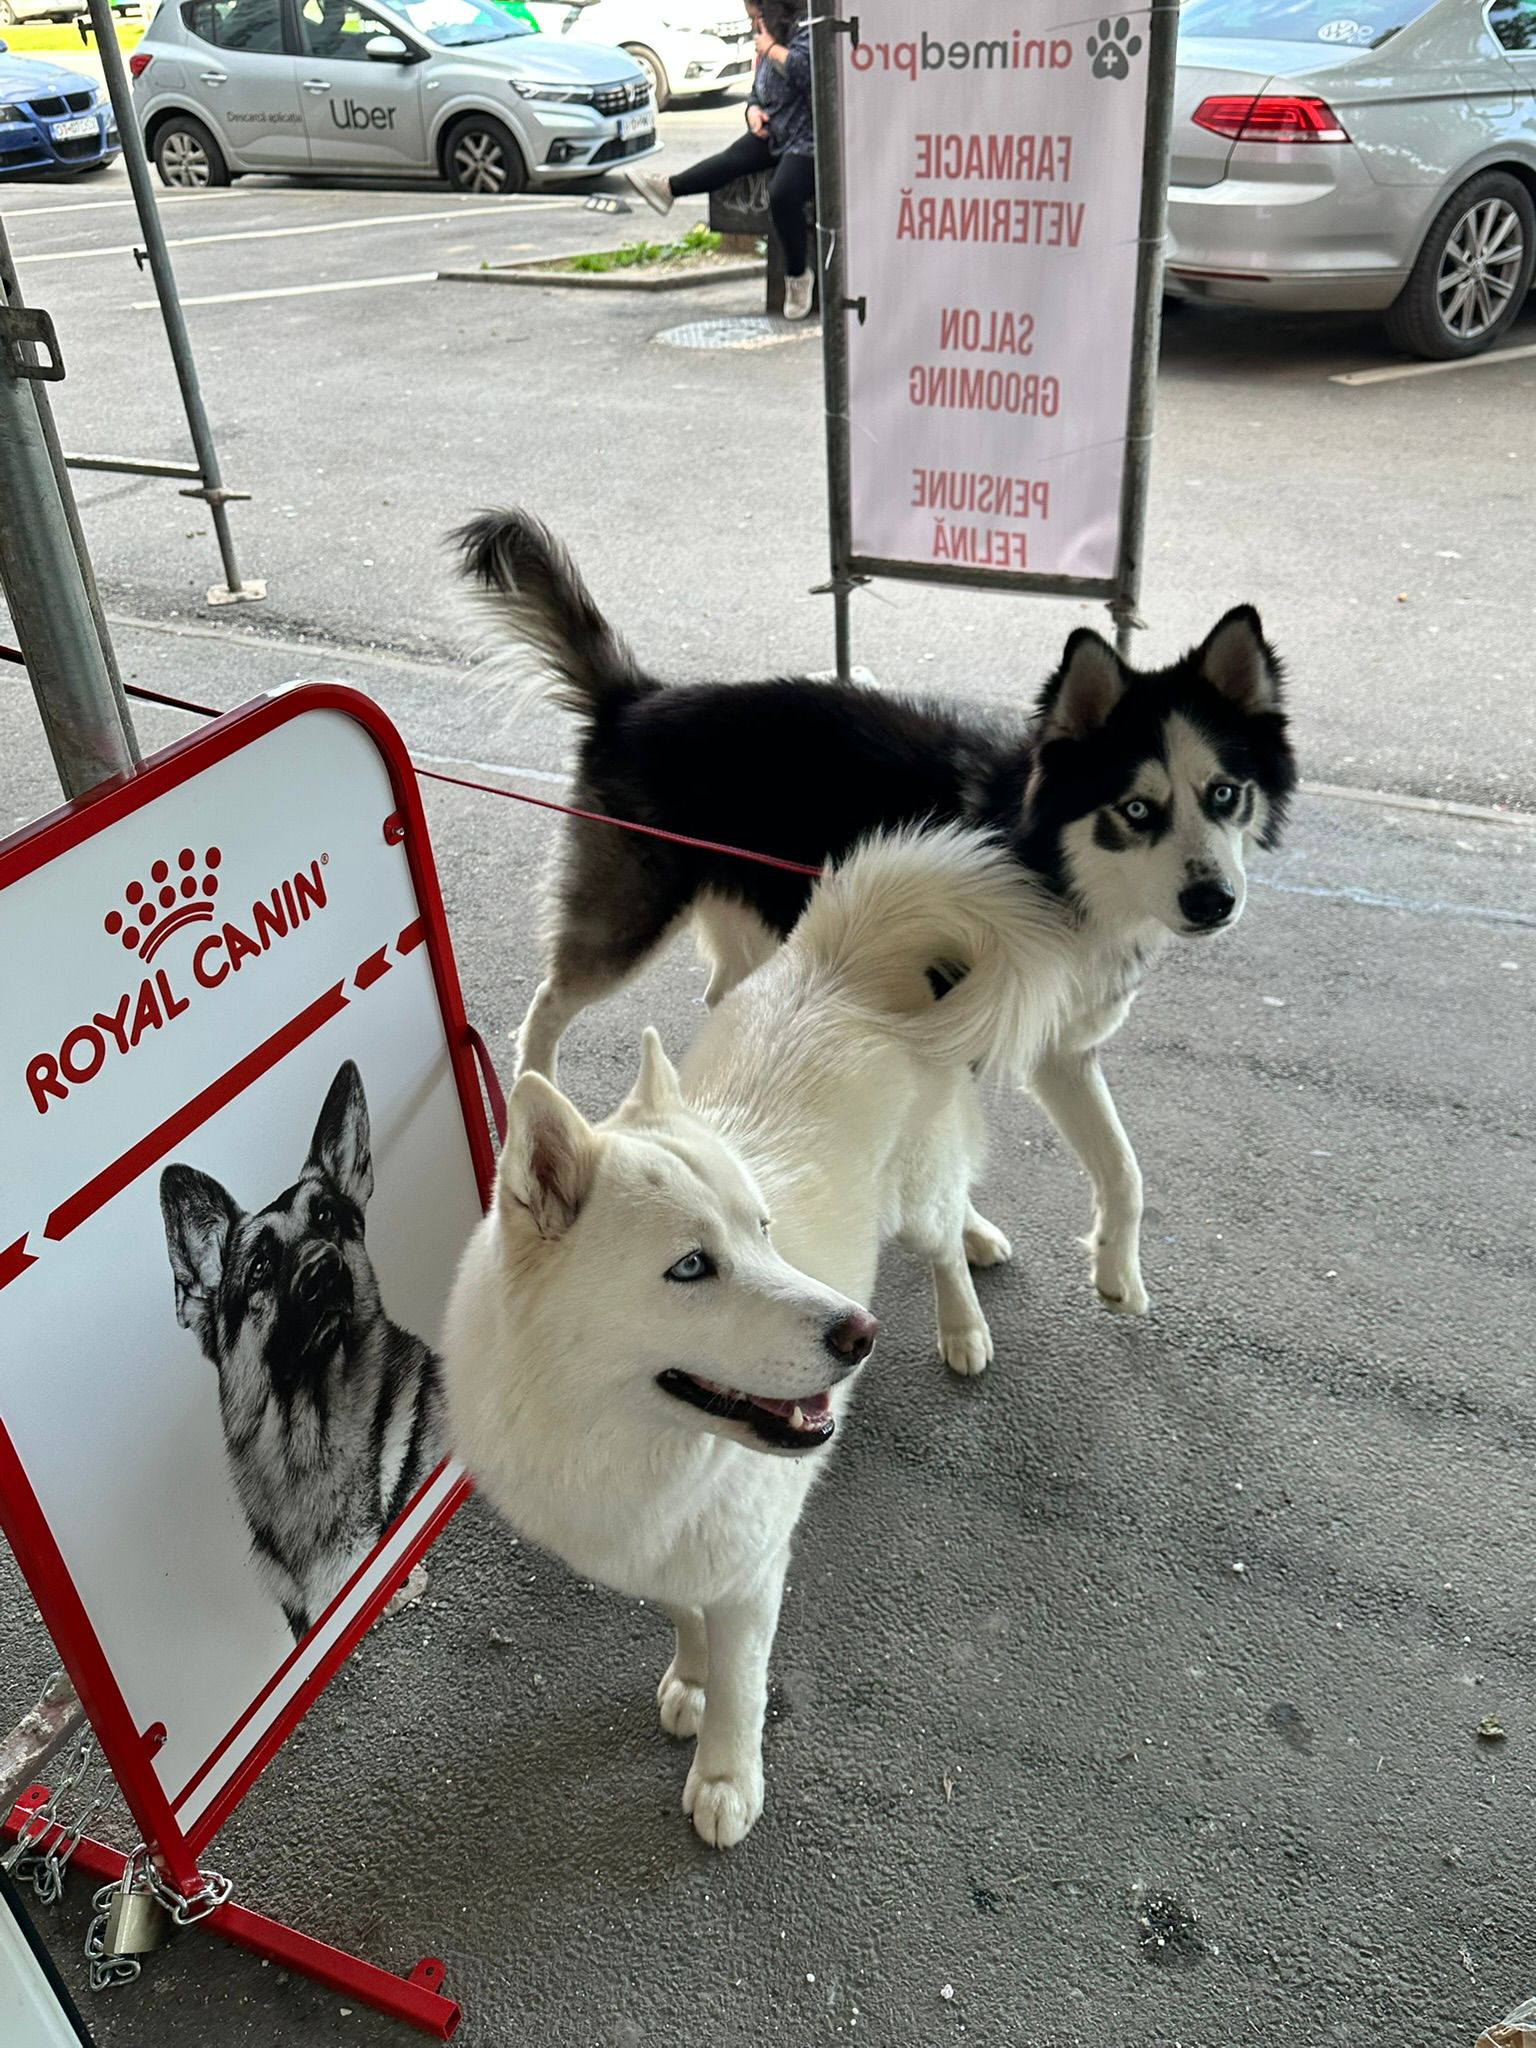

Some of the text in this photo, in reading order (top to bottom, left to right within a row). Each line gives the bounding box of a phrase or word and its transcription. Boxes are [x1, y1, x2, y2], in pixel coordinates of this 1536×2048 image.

[329, 98, 397, 130] Uber
[25, 859, 328, 1115] ROYAL CANIN
